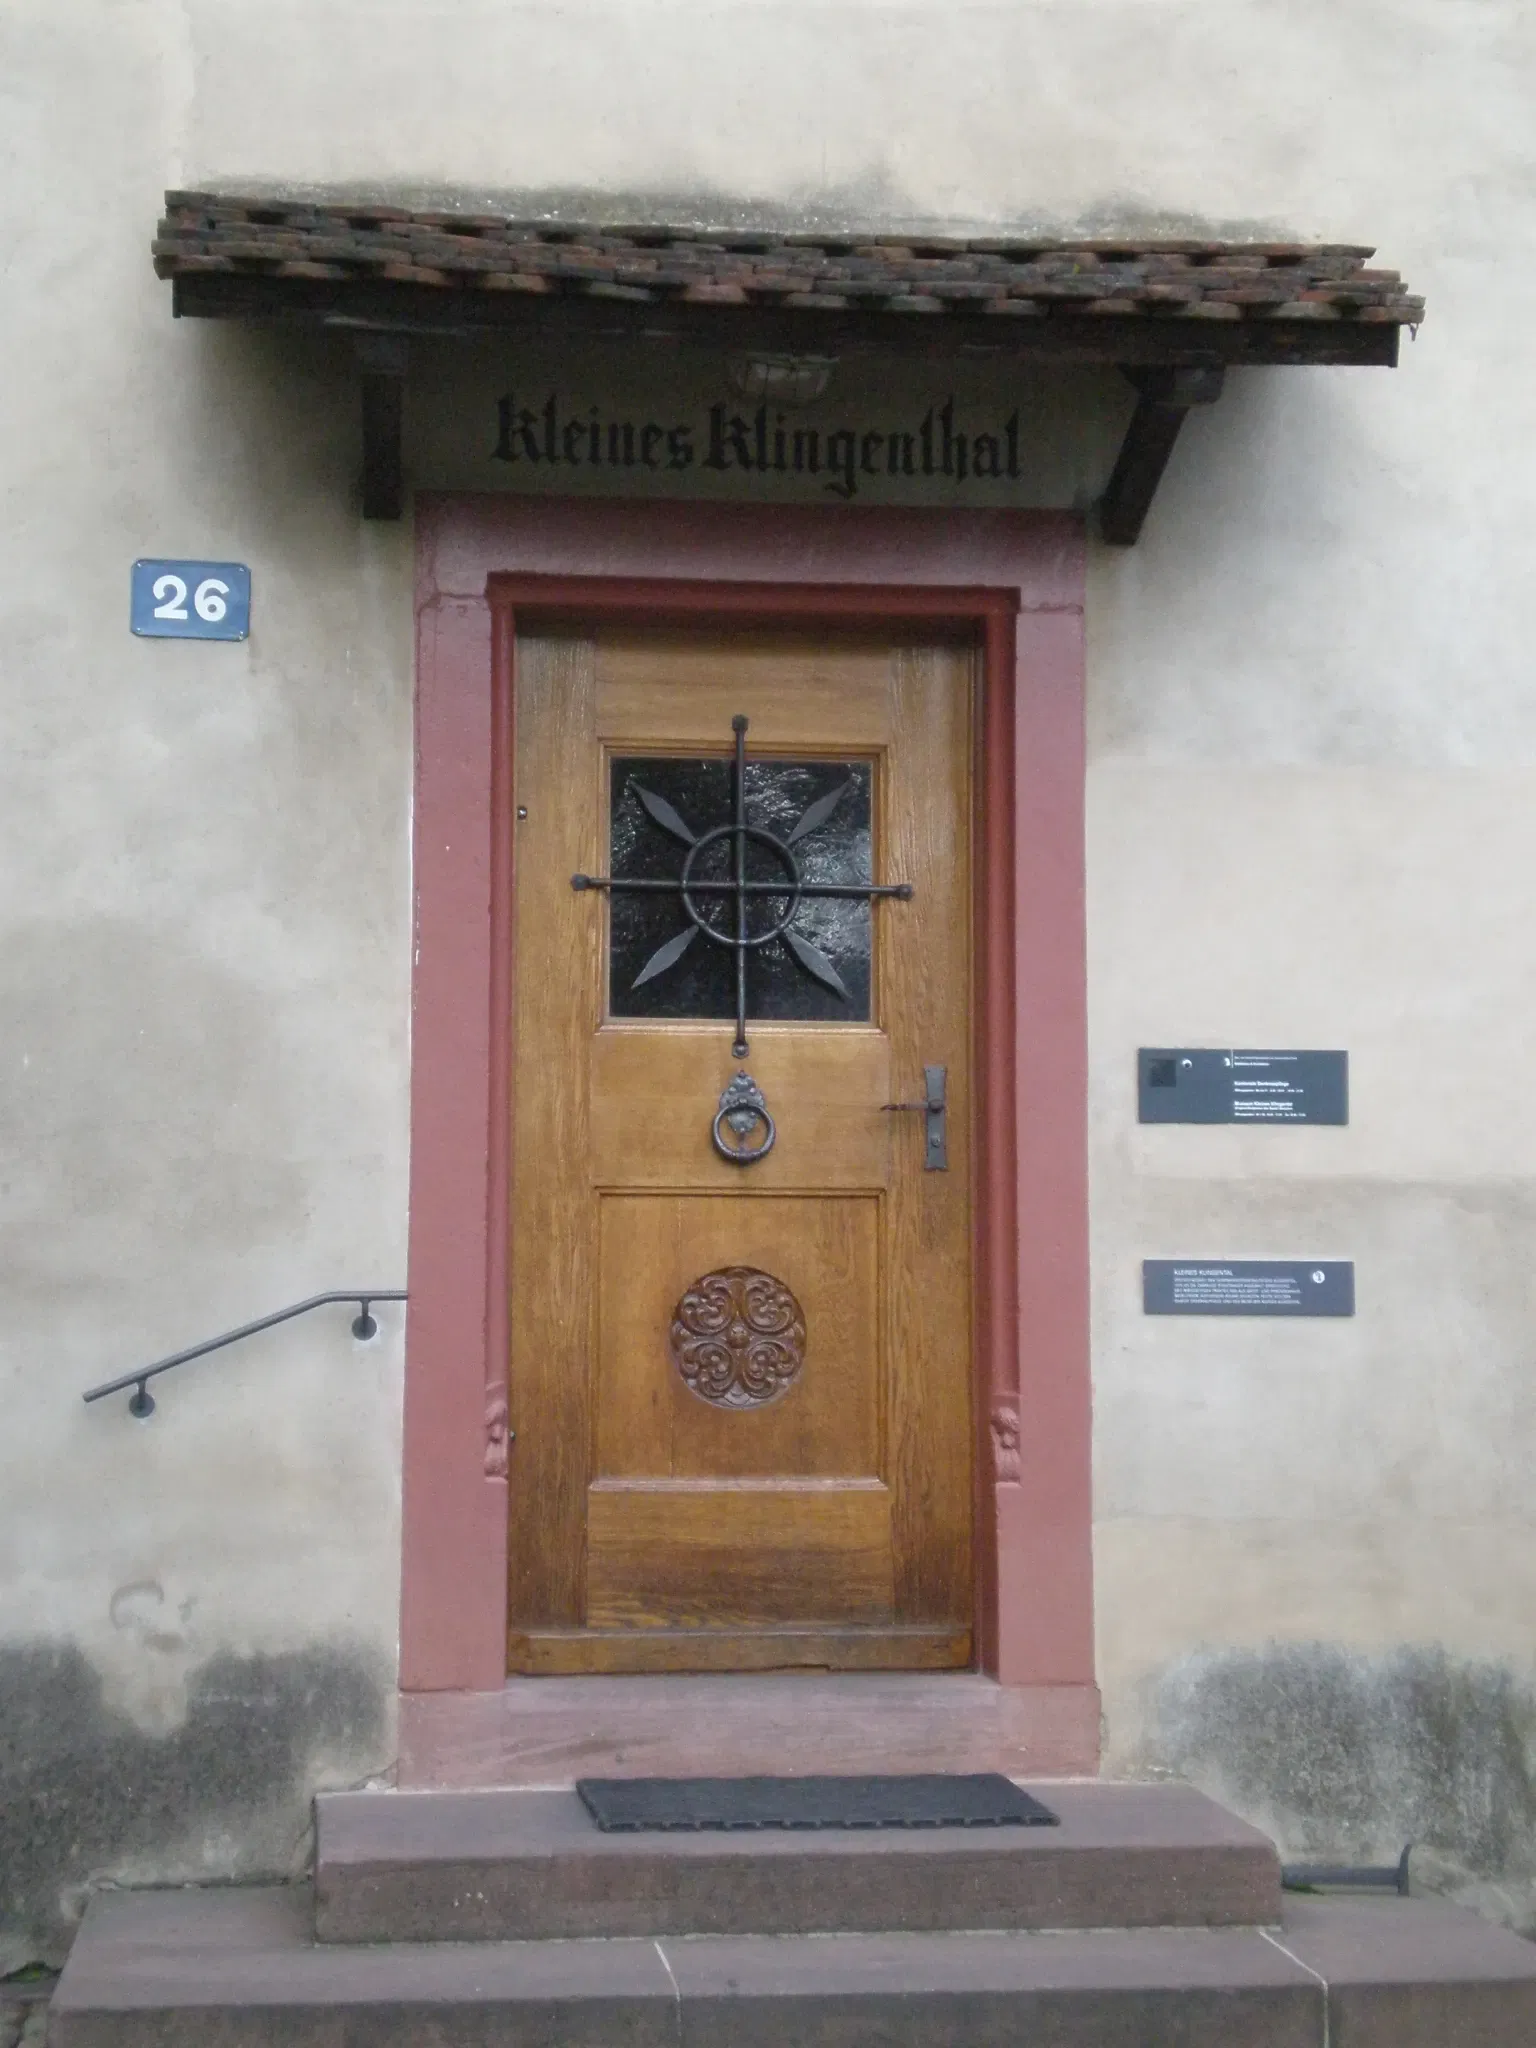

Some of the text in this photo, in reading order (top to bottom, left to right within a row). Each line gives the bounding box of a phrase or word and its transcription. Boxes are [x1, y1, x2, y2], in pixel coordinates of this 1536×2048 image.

[490, 392, 1022, 499] Kleines Klingenthal
[152, 574, 230, 622] 26
